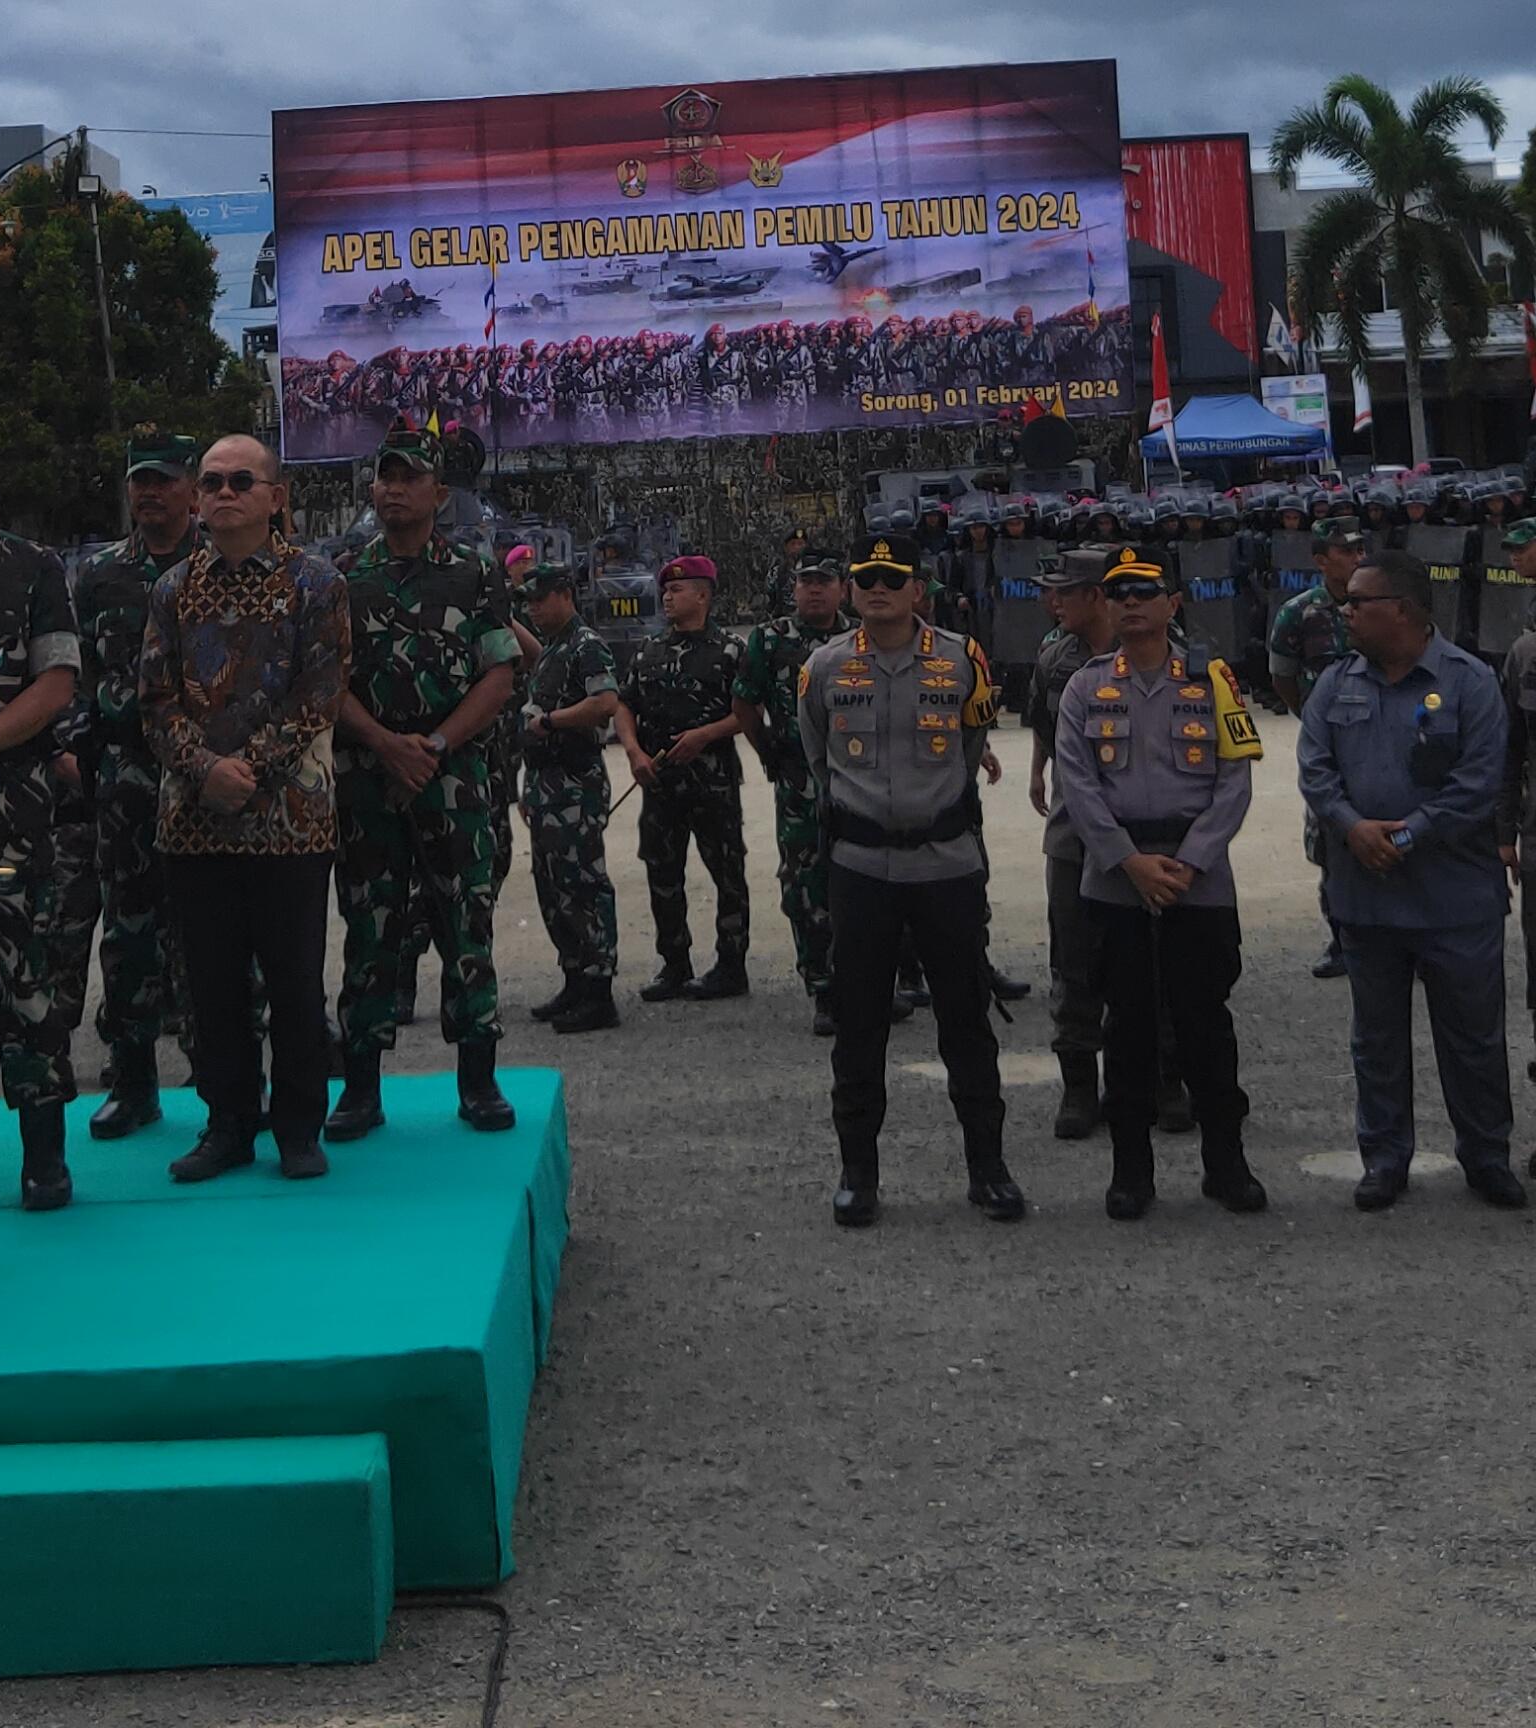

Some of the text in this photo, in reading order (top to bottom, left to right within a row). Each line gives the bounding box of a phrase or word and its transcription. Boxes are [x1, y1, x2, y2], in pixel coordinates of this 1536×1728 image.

[322, 191, 1080, 273] APEL GELAR PENGAMANAN PEMILU TAHUN 2024
[861, 379, 1120, 414] Sorong, 01 Februari 2024
[1209, 438, 1290, 452] PERHUBUNGAN
[610, 598, 639, 616] TNI
[833, 693, 960, 707] HAPPY POLRI
